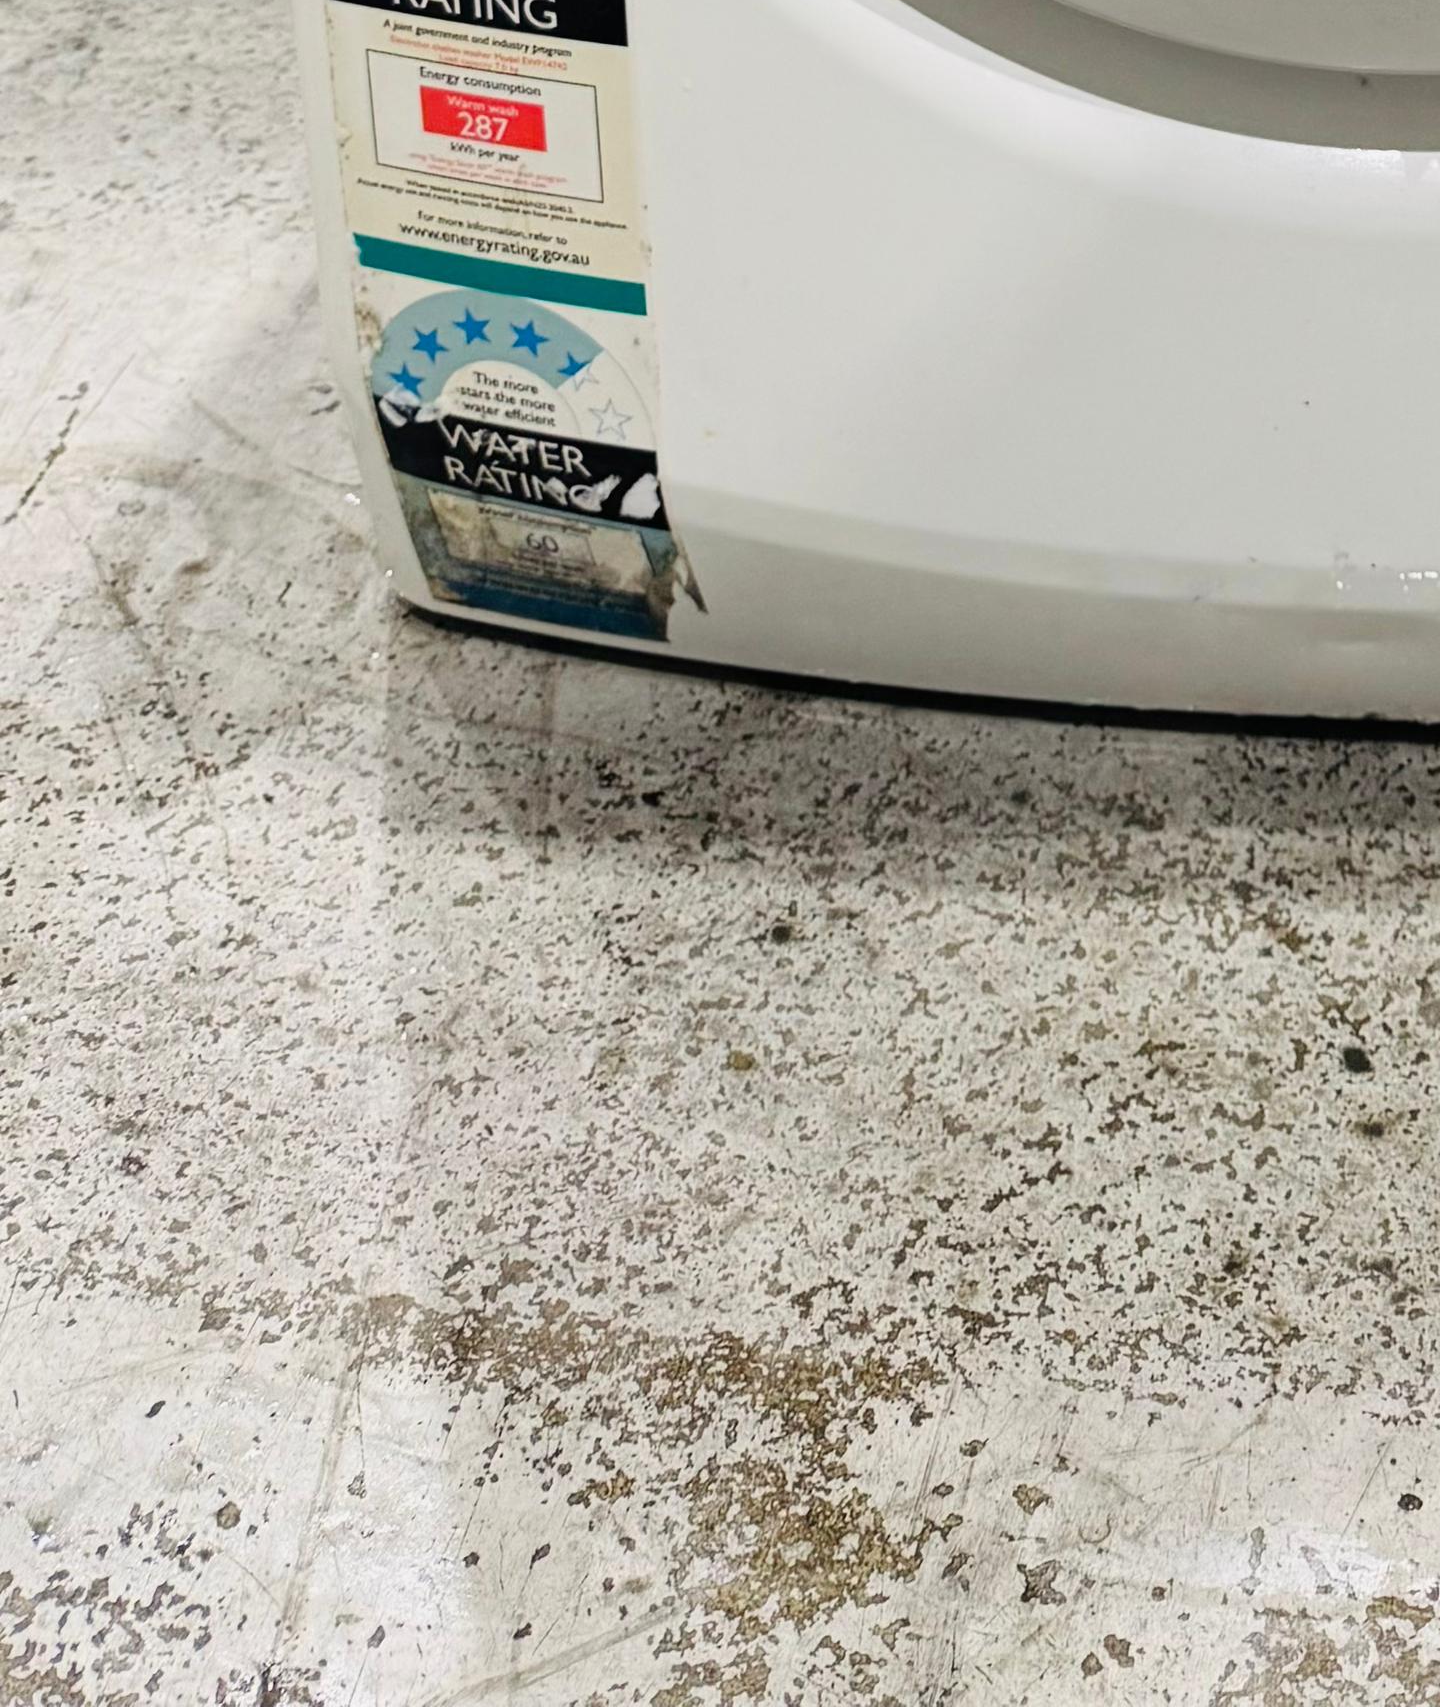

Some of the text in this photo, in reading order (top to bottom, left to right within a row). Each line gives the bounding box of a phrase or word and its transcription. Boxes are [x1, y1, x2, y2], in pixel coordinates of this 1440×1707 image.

[491, 38, 529, 54] industry
[419, 66, 541, 96] Energy consumption
[447, 95, 519, 118] Warm wash
[457, 111, 510, 142] 287
[398, 222, 590, 266] www.energyrating.gov.au
[556, 237, 568, 246] to
[472, 371, 539, 394] The more
[459, 387, 556, 412] stars the more
[463, 402, 556, 427] water efficient
[438, 415, 592, 477] WATER
[526, 532, 560, 554] 60
